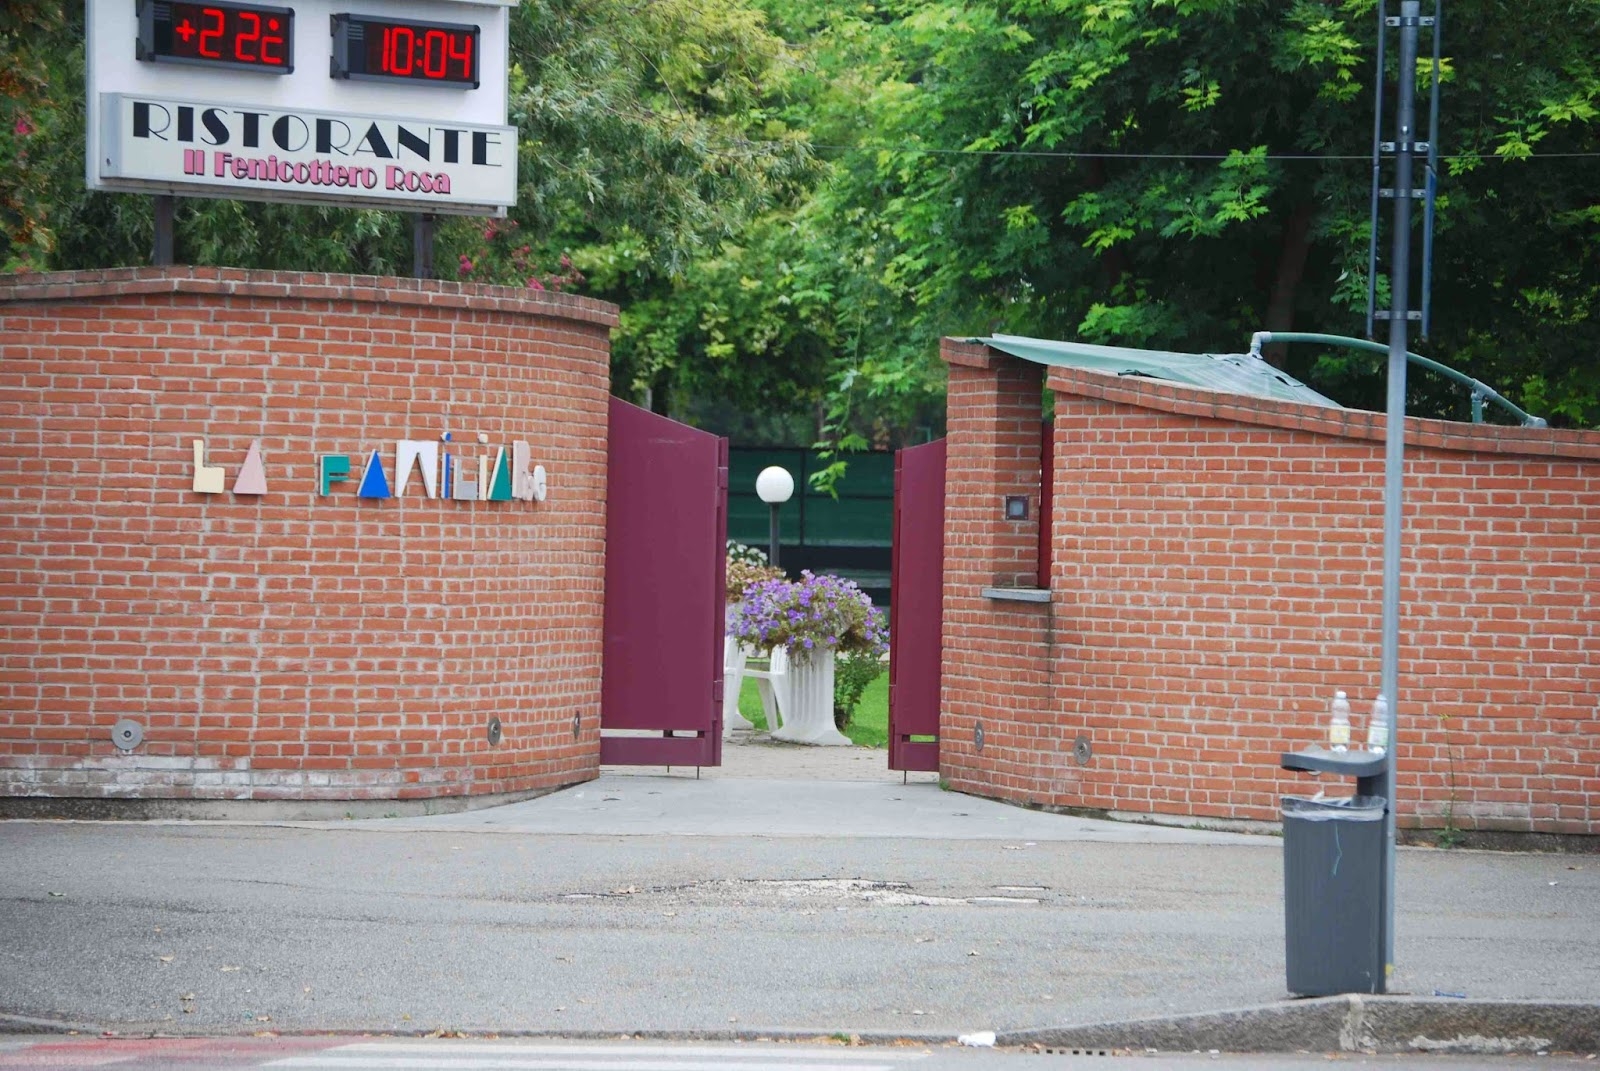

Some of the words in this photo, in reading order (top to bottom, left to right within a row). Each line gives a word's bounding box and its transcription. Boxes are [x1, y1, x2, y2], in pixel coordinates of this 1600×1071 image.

[382, 28, 473, 79] 10:04
[133, 101, 502, 167] RISTORANTE
[214, 151, 378, 189] Fenicottero
[385, 164, 452, 195] Rosa
[193, 439, 268, 495] LA
